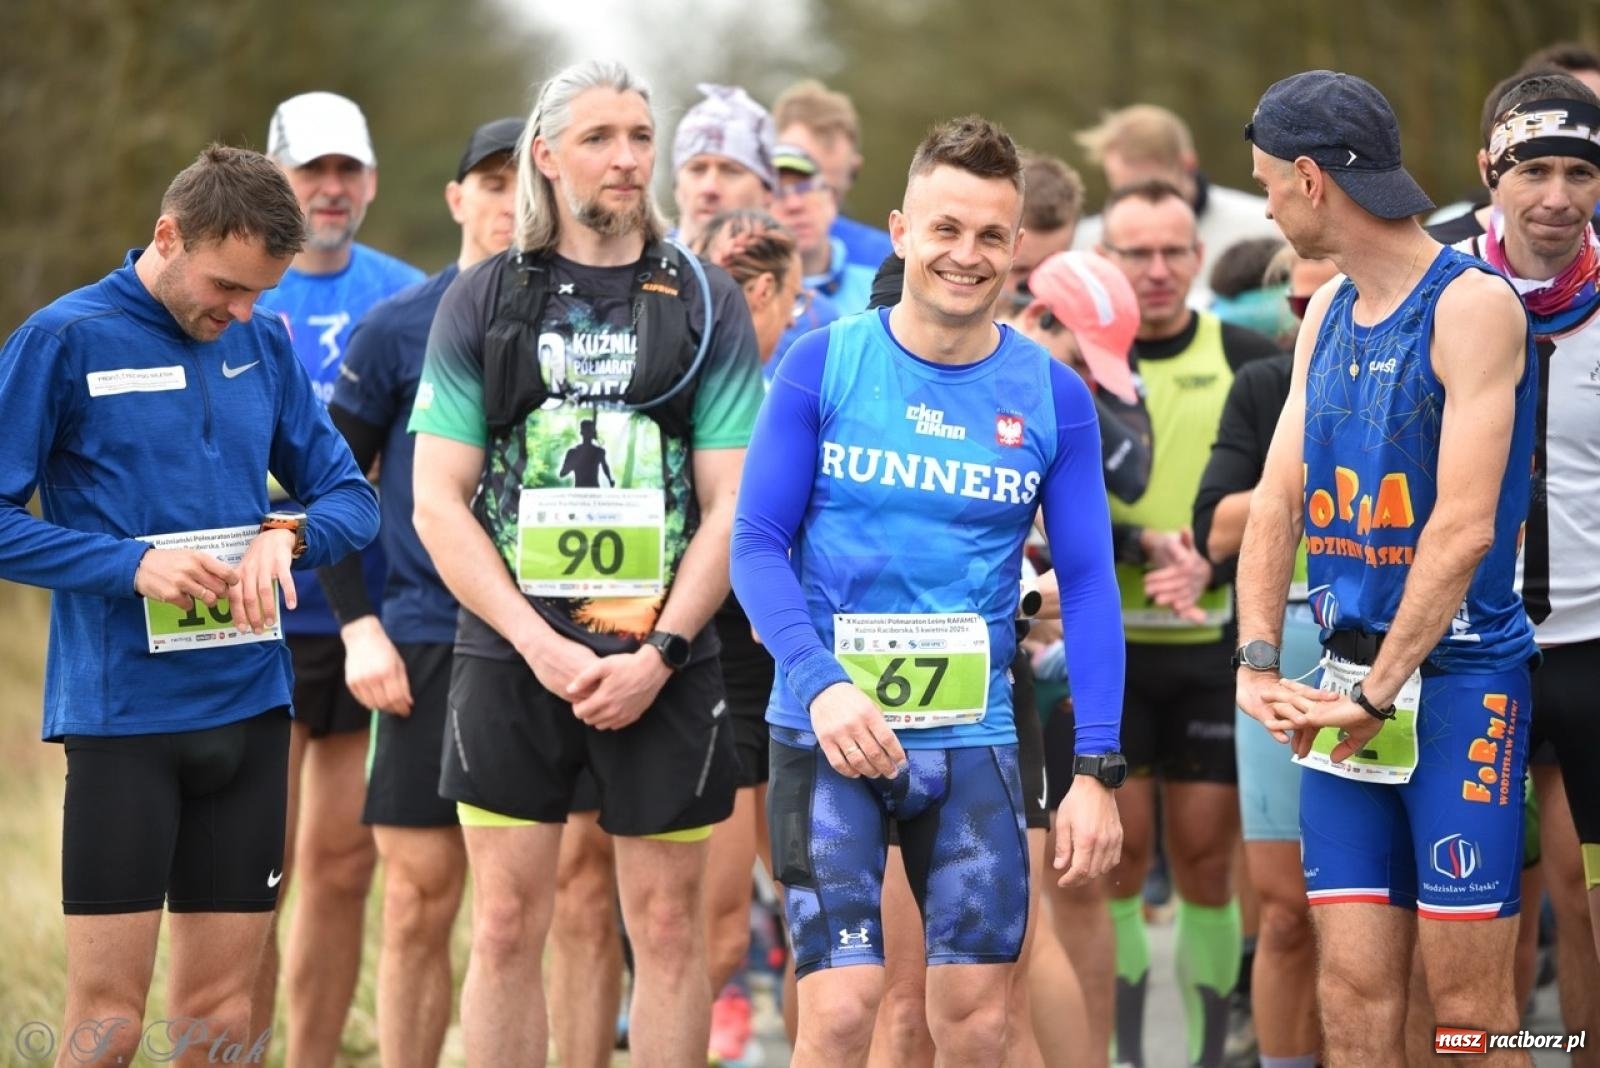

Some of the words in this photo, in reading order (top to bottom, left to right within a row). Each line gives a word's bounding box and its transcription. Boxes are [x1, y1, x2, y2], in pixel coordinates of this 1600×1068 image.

[573, 359, 637, 375] PÓŁMARAT
[822, 441, 1041, 504] RUNNERS
[557, 529, 625, 576] 90
[876, 657, 950, 708] 67
